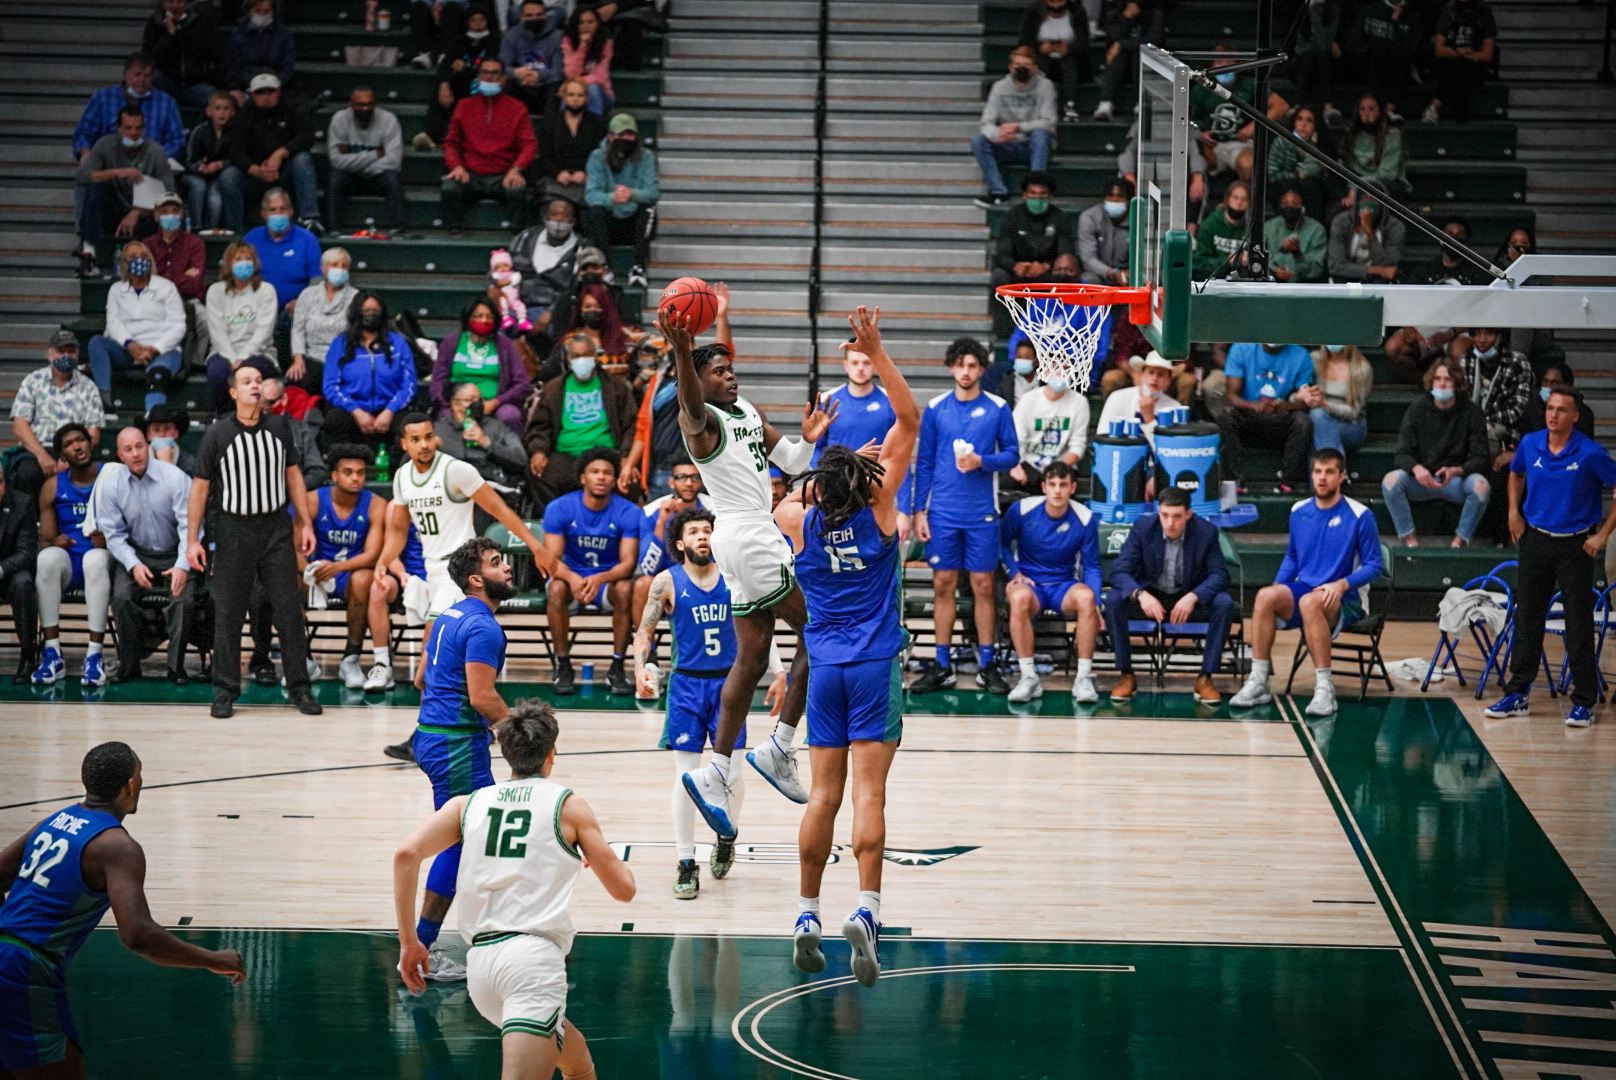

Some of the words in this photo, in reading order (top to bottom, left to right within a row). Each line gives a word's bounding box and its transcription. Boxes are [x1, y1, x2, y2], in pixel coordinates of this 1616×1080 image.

[1156, 446, 1216, 458] POWERADE
[409, 496, 443, 509] ATTERS
[416, 512, 439, 536] 30
[327, 529, 358, 544] FGCU
[577, 535, 608, 550] FGCU
[640, 541, 663, 577] FGCU
[823, 544, 867, 574] 15
[691, 603, 728, 624] FGCU
[433, 624, 445, 665] 1
[703, 627, 721, 656] 5
[496, 785, 533, 802] SMITH
[485, 807, 532, 858] 12
[18, 831, 69, 889] 32
